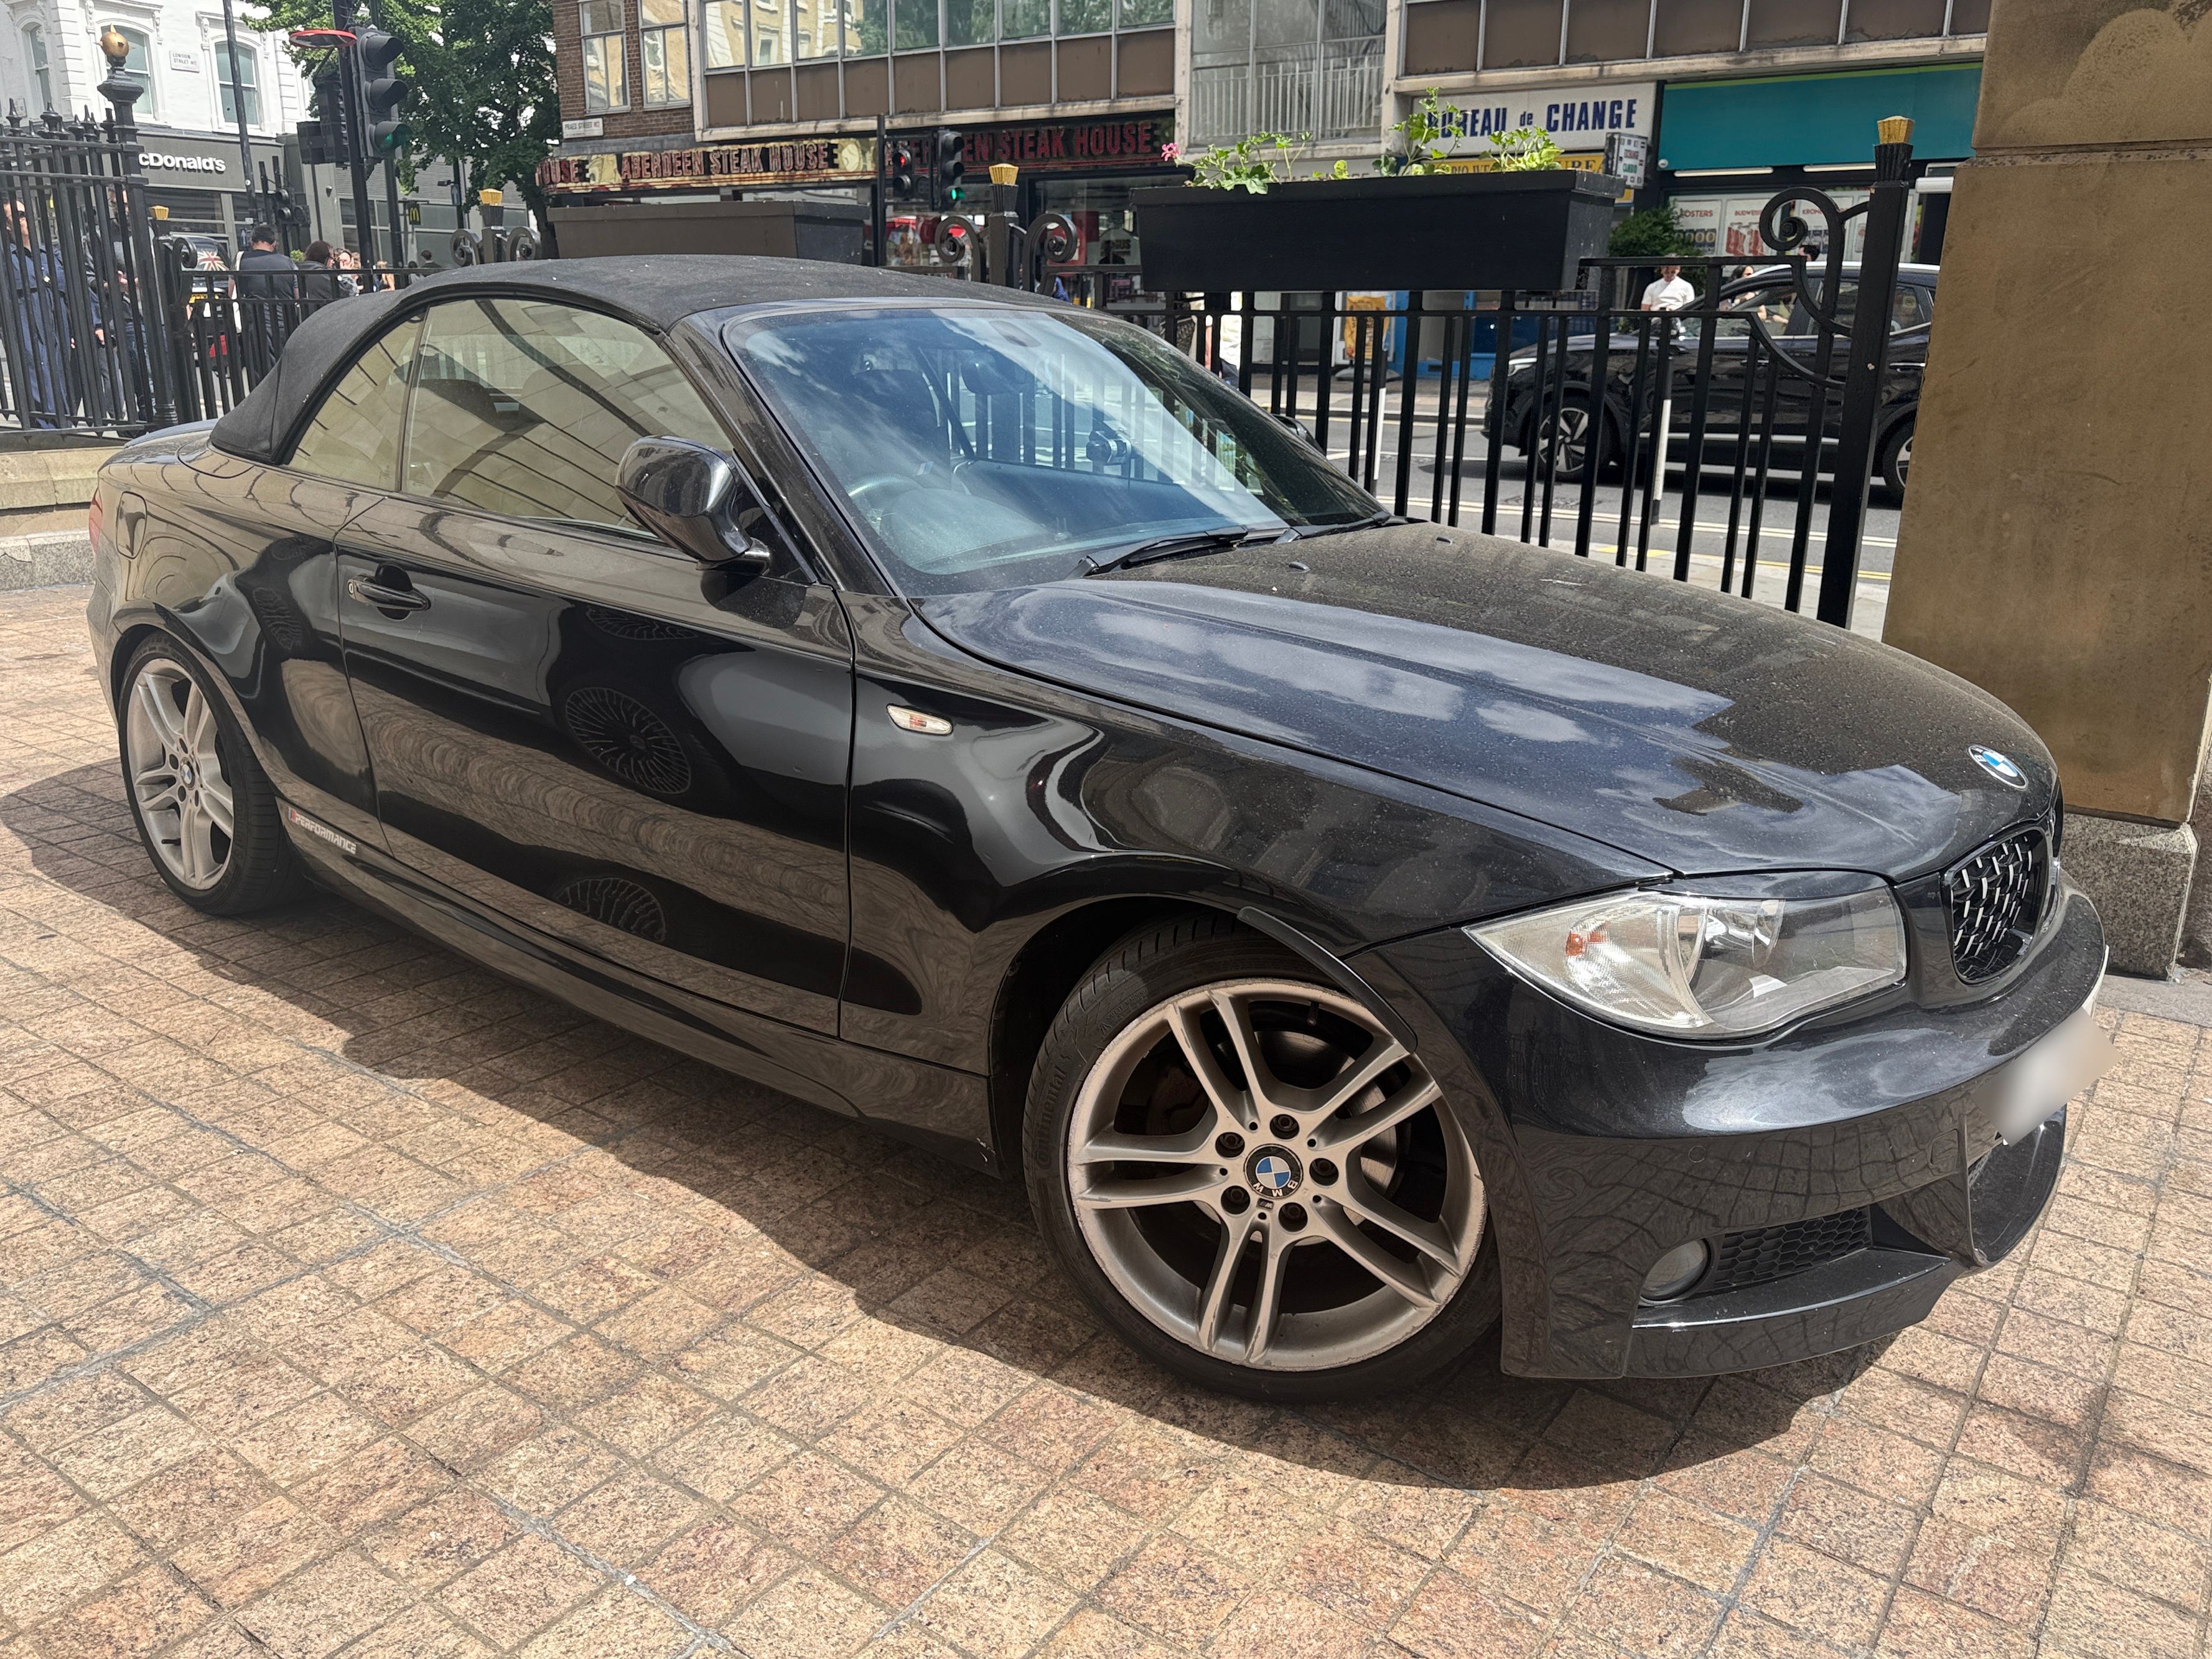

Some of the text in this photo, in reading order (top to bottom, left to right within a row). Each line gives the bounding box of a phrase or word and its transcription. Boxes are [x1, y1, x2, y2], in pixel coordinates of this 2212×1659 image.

[1519, 111, 1533, 126] de
[1546, 99, 1637, 132] CHANGE
[999, 128, 1065, 161] STEAK
[1075, 121, 1152, 157] HOUSE
[138, 152, 226, 172] cDonald's
[622, 142, 829, 179] ABERDEEN STEAK HOUSE
[295, 813, 357, 856] PERFORMANCE
[1035, 1064, 1066, 1170] Continental
[1253, 1179, 1299, 1197] BMW
